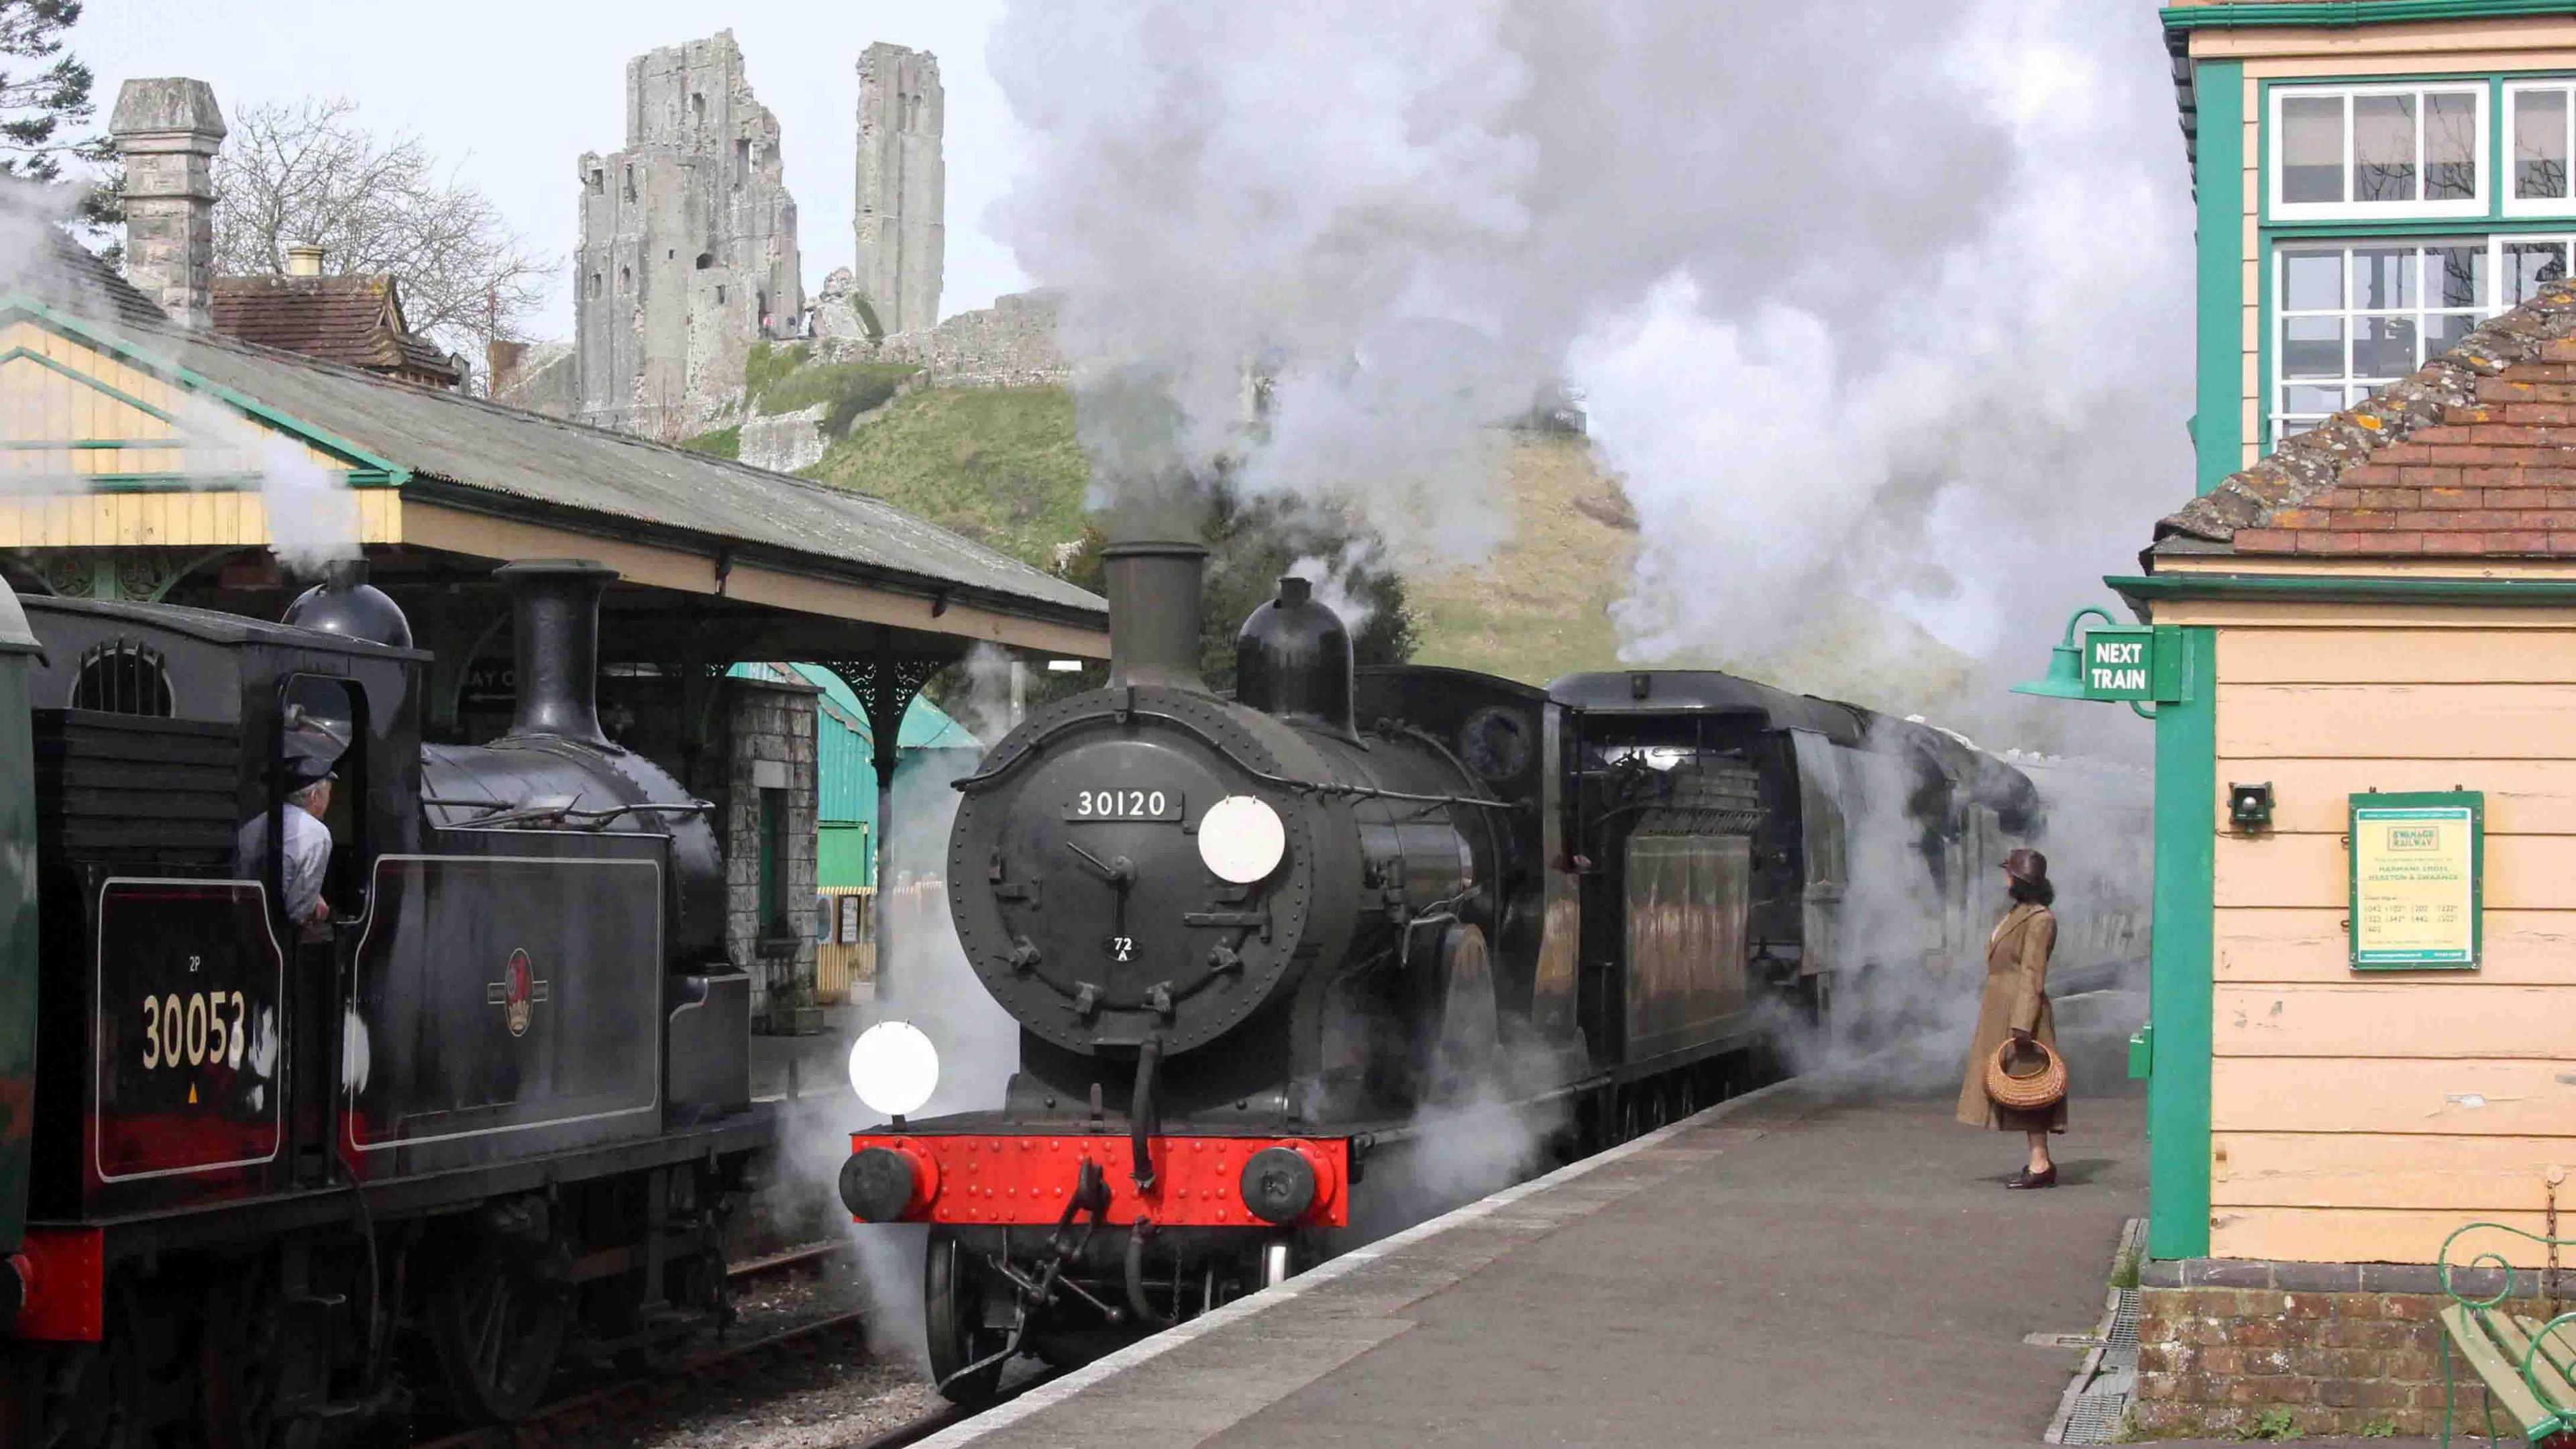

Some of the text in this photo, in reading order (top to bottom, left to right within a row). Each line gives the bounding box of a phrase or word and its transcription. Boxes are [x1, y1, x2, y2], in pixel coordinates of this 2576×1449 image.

[2096, 643, 2142, 663] NEXT
[2091, 668, 2145, 690] TRAIN
[1077, 791, 1165, 816] 30120
[1114, 938, 1132, 950] 72
[189, 956, 201, 971] 2P
[1118, 950, 1127, 961] A
[143, 991, 245, 1070] 30053
